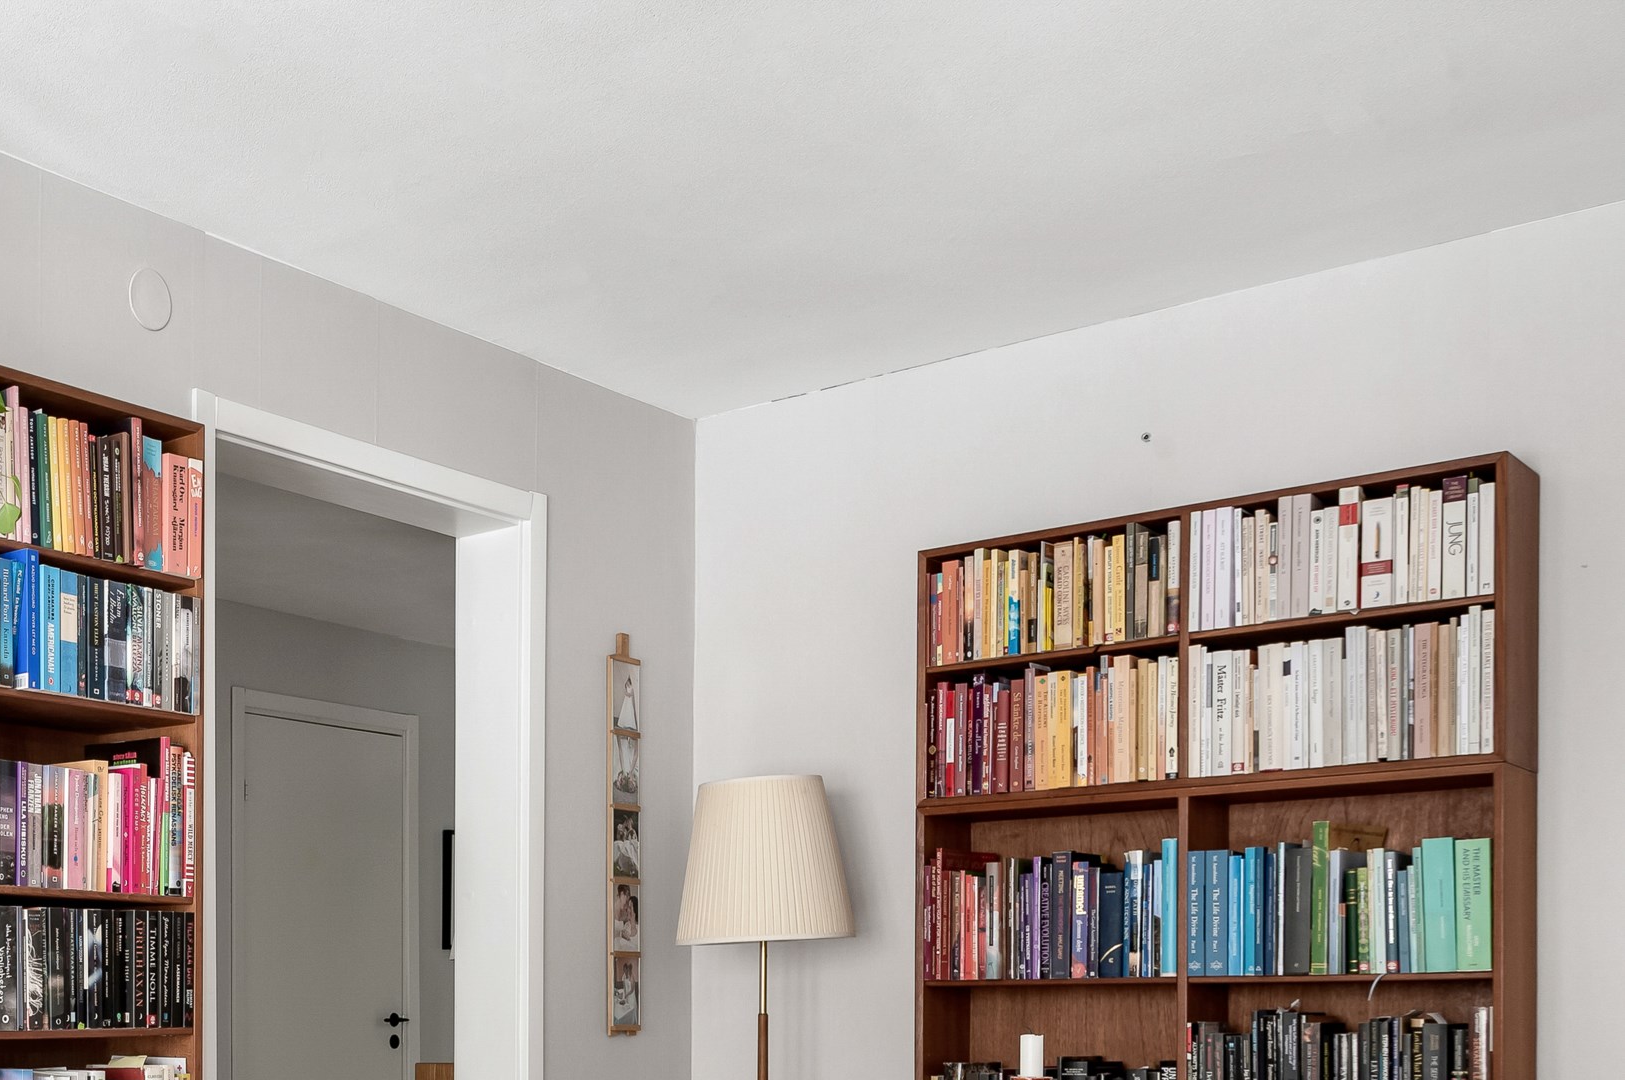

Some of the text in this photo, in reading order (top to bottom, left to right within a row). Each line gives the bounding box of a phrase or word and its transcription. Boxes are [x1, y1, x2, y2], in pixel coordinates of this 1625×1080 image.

[1446, 521, 1463, 556] JUNG
[116, 589, 124, 618] Ensam
[47, 622, 55, 673] AMERICANAH
[1217, 665, 1226, 722] Mäster Fritz.
[1013, 692, 1021, 741] Så tänkte de
[1462, 848, 1470, 865] AND
[1076, 875, 1086, 915] untamed
[1473, 865, 1481, 895] MASTER
[1463, 882, 1471, 920] EMISSARY
[1041, 882, 1049, 964] CREATIVE EVOLUTION
[136, 918, 145, 1007] APRILHÄXAN
[1414, 1054, 1422, 1073] What
[1473, 1038, 1481, 1068] SERVANT
